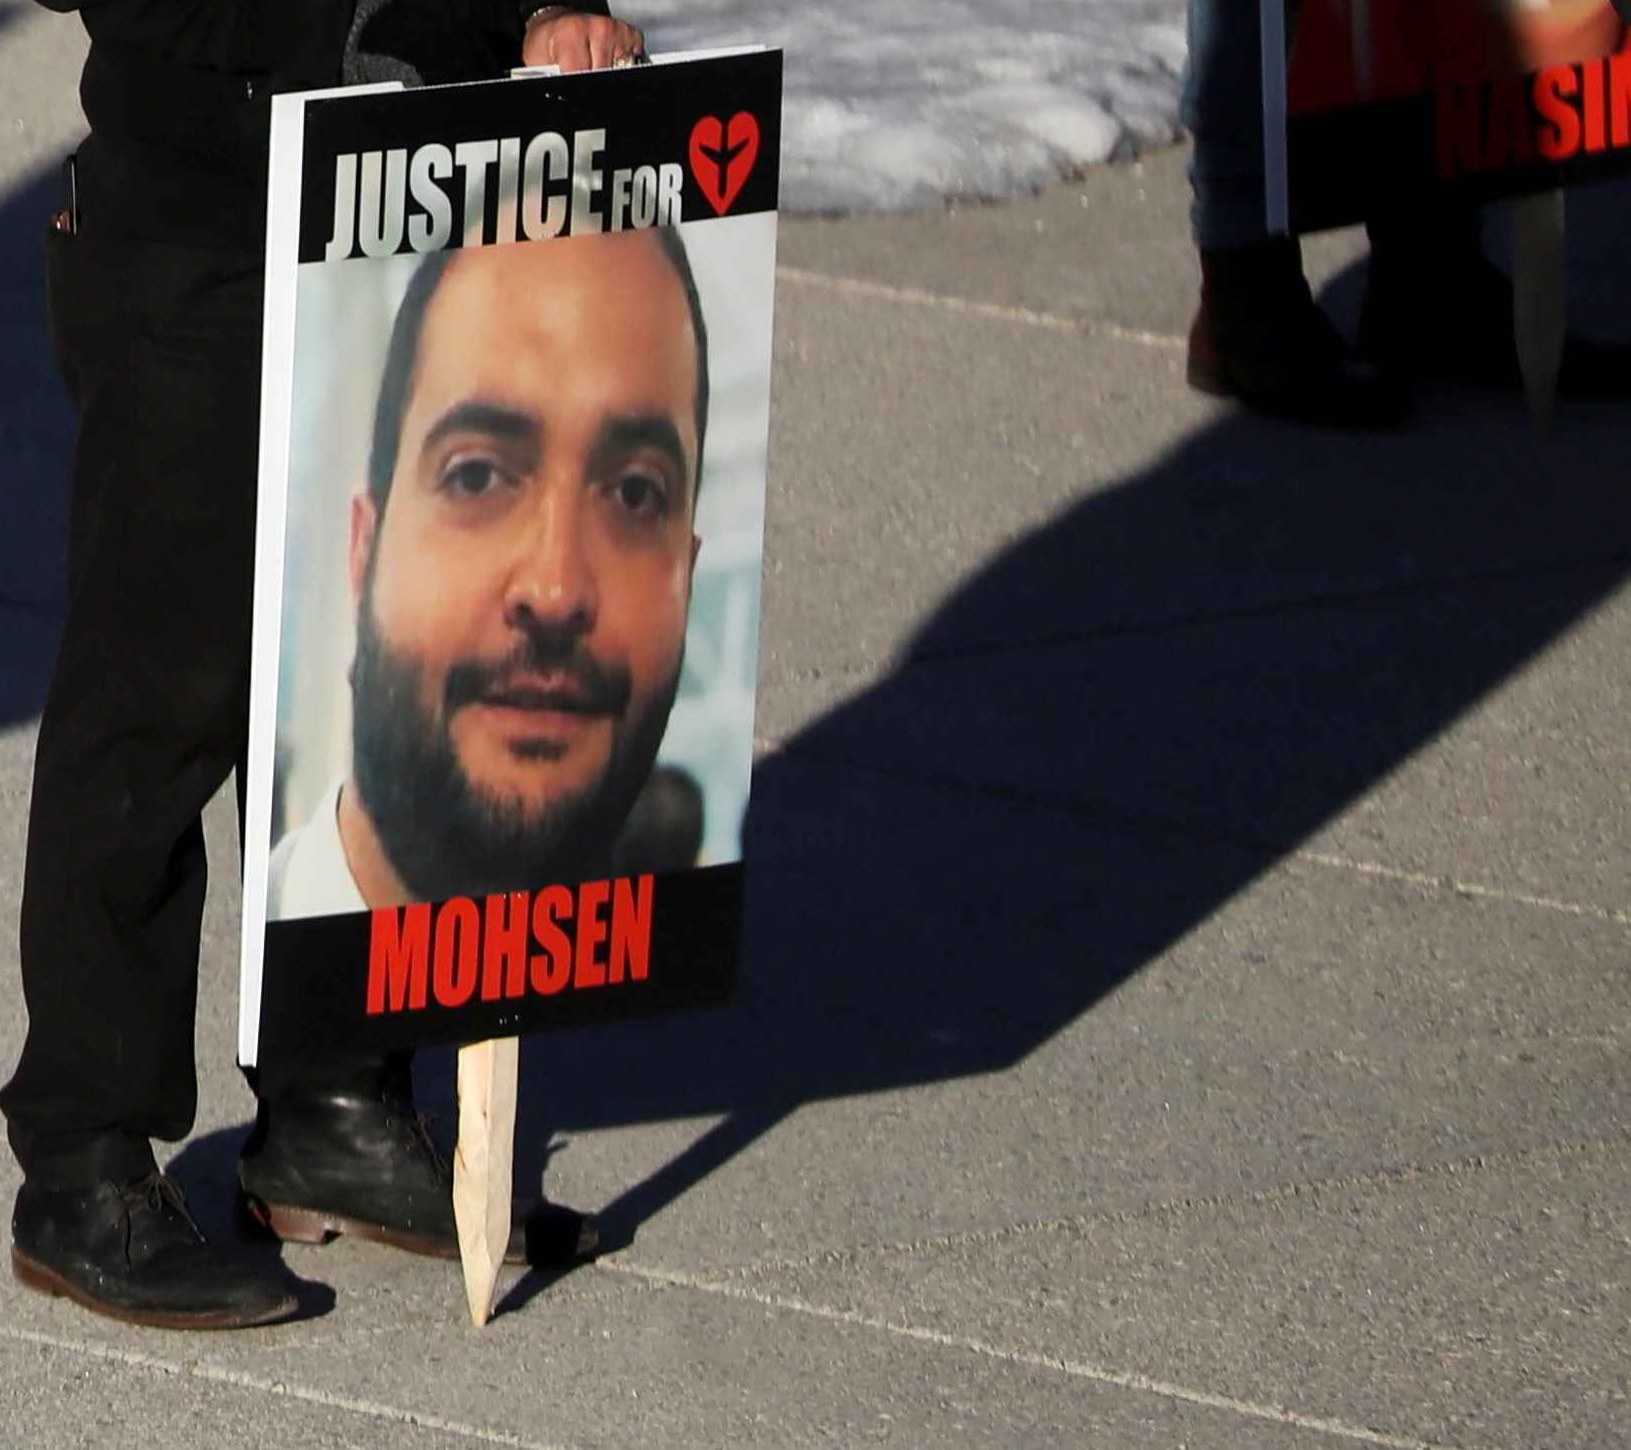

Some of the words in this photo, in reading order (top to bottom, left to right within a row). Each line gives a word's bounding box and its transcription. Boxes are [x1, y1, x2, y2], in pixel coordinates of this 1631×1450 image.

[324, 129, 605, 263] JUSTICE
[611, 163, 683, 231] FOR
[366, 874, 654, 1016] MOHSEN
